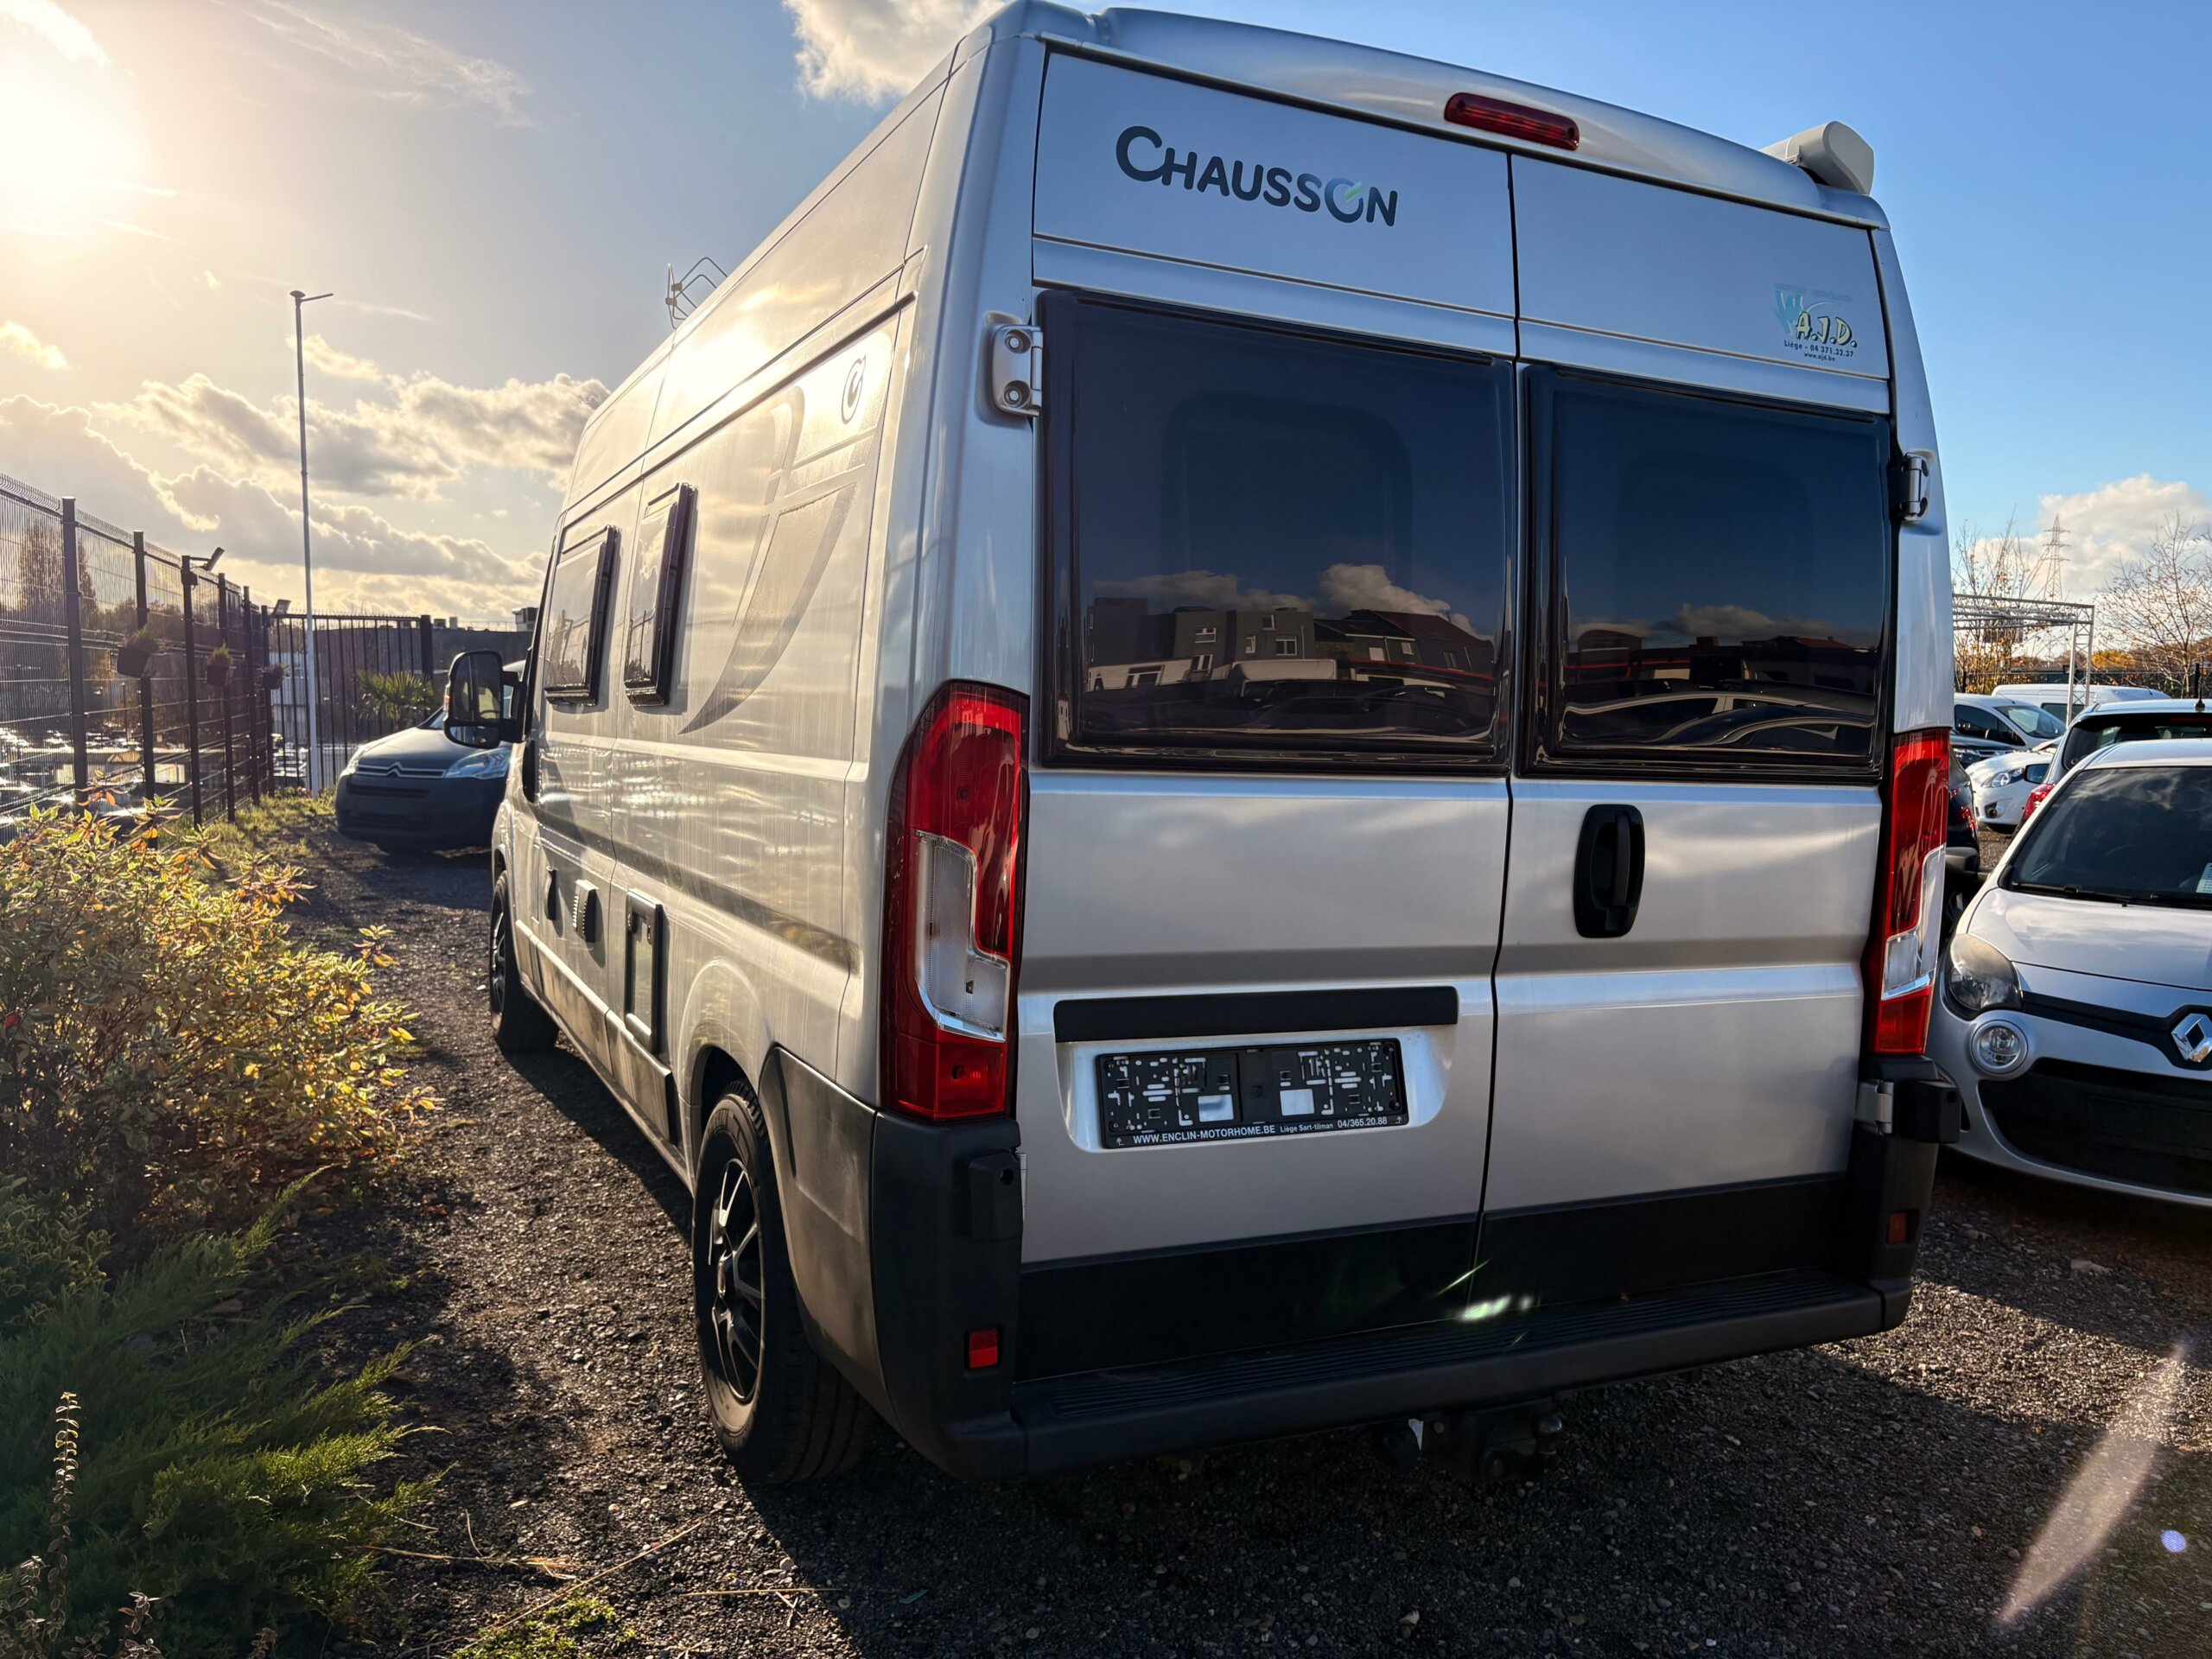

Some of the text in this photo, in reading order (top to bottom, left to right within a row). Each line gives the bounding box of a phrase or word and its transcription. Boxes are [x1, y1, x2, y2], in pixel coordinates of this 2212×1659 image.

[1116, 125, 1398, 227] CHAUSSON
[1796, 311, 1858, 348] A.J.D.
[1783, 340, 1803, 350] Liège
[1821, 346, 1854, 358] 371.32.37
[1133, 1116, 1388, 1144] WWW.ENCLIN-MOTORHOME.BE Liège Sart-tilman 04/365.20.88
